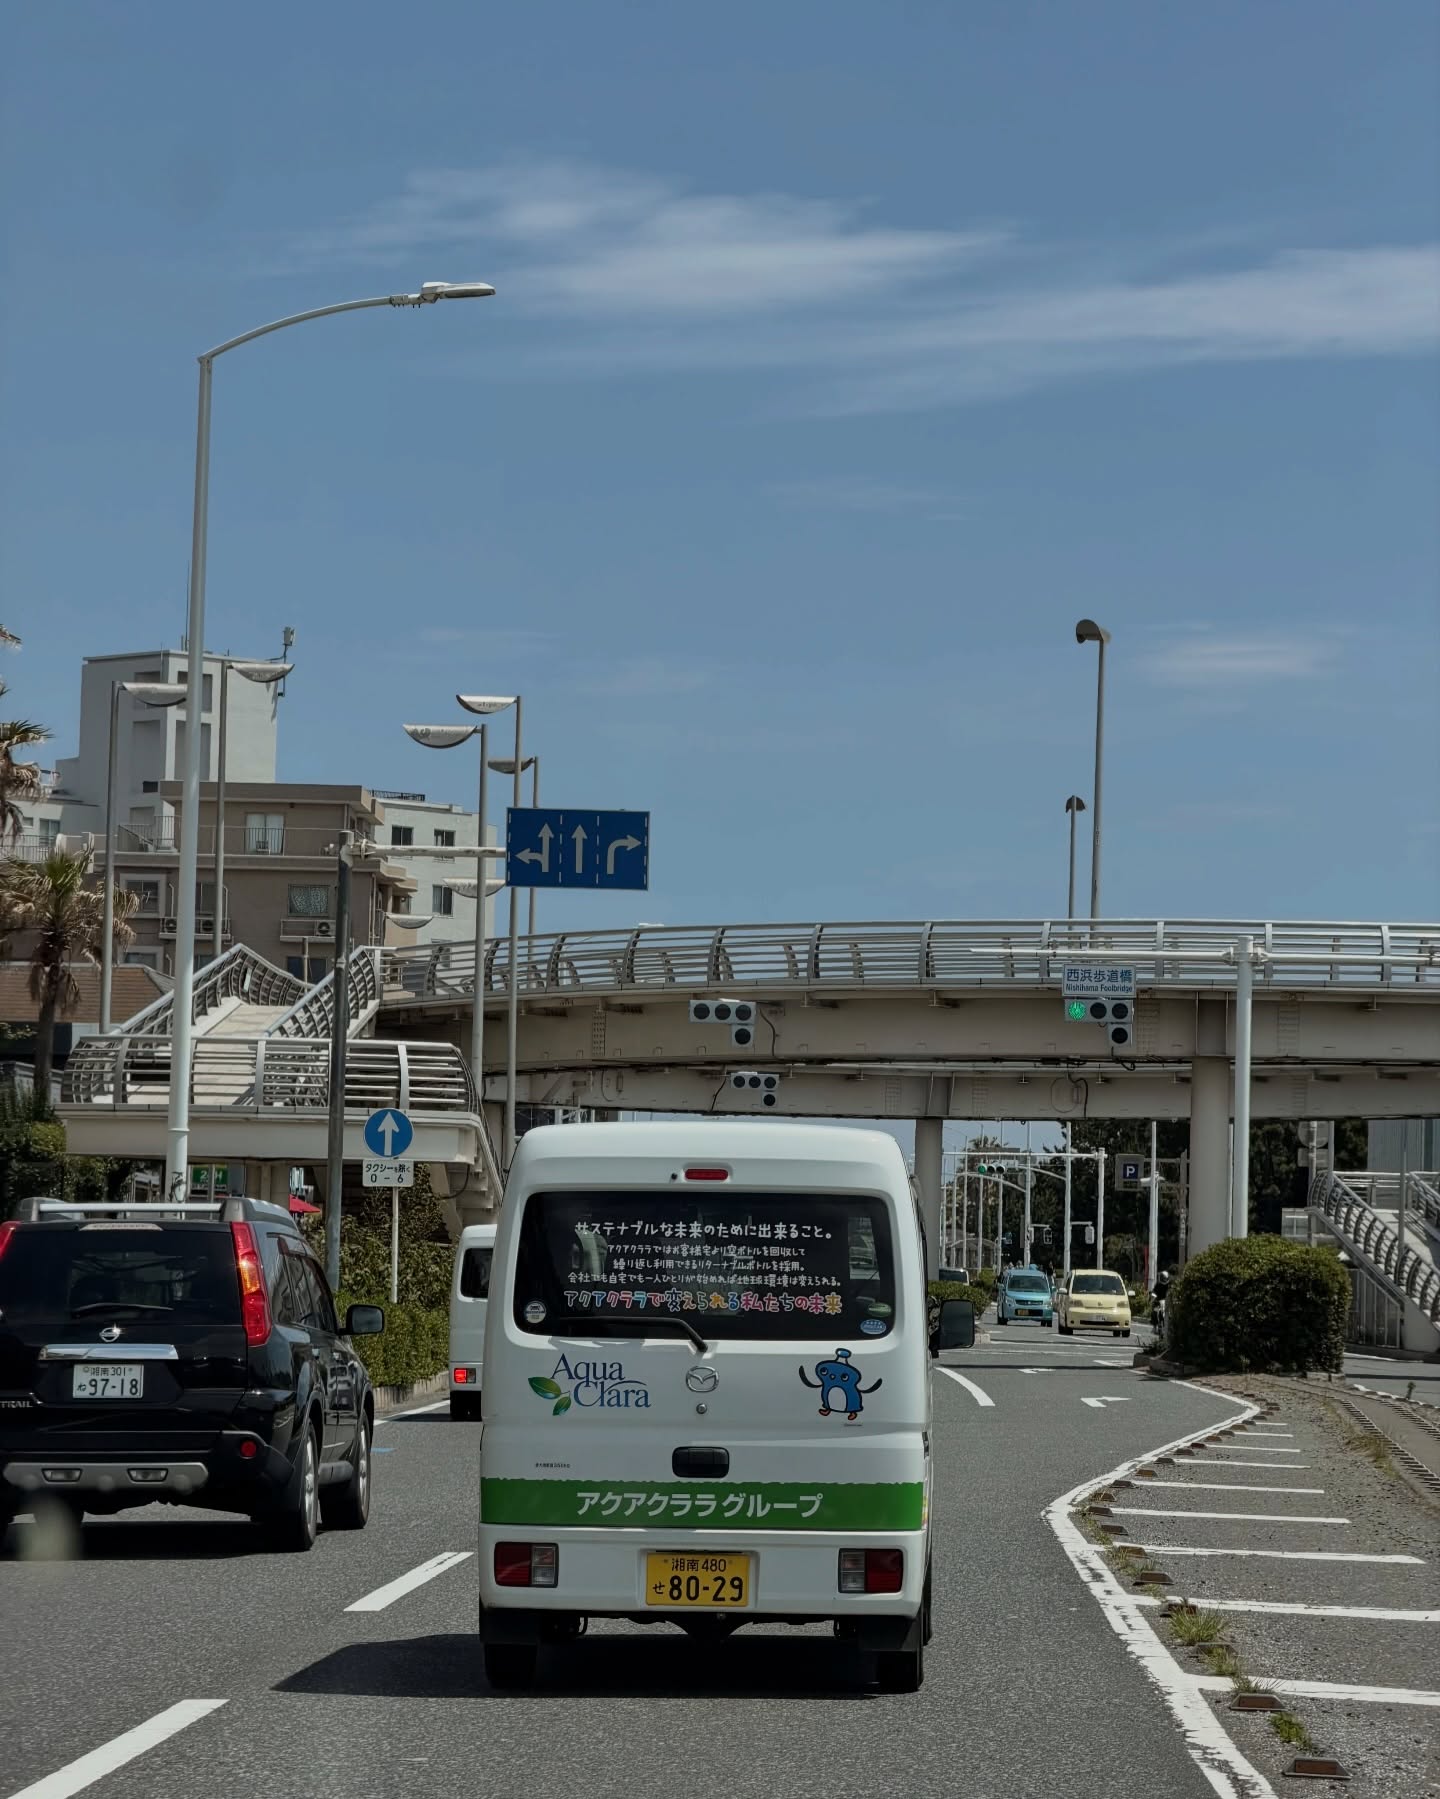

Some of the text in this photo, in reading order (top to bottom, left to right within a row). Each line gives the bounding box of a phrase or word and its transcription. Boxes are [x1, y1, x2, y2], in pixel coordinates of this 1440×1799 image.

[1066, 968, 1132, 983] 西浜歩道橋
[1066, 983, 1133, 994] Nishihama Footbridge
[365, 1163, 411, 1173] タクシーを除く
[574, 1220, 832, 1241] サステナブルな未来のために出来ること。
[607, 1243, 806, 1258] アクアクララではお客様宅より空ボトルを回収して
[613, 1258, 805, 1273] 繰り返し利用できるリターナブルボトルを採用。
[567, 1271, 841, 1288] 会社でも自宅でも一人ひとりが始めれば地球環境は変えられる。
[563, 1287, 843, 1315] アクアクララで変えられる私たちの未来
[111, 1367, 126, 1377] 301
[551, 1353, 625, 1387] Aqua
[88, 1378, 139, 1396] 97-18
[573, 1380, 651, 1409] Clara
[576, 1491, 823, 1518] アクアクララグループ
[671, 1557, 727, 1573] 湘南 480
[668, 1576, 744, 1602] 80-29
